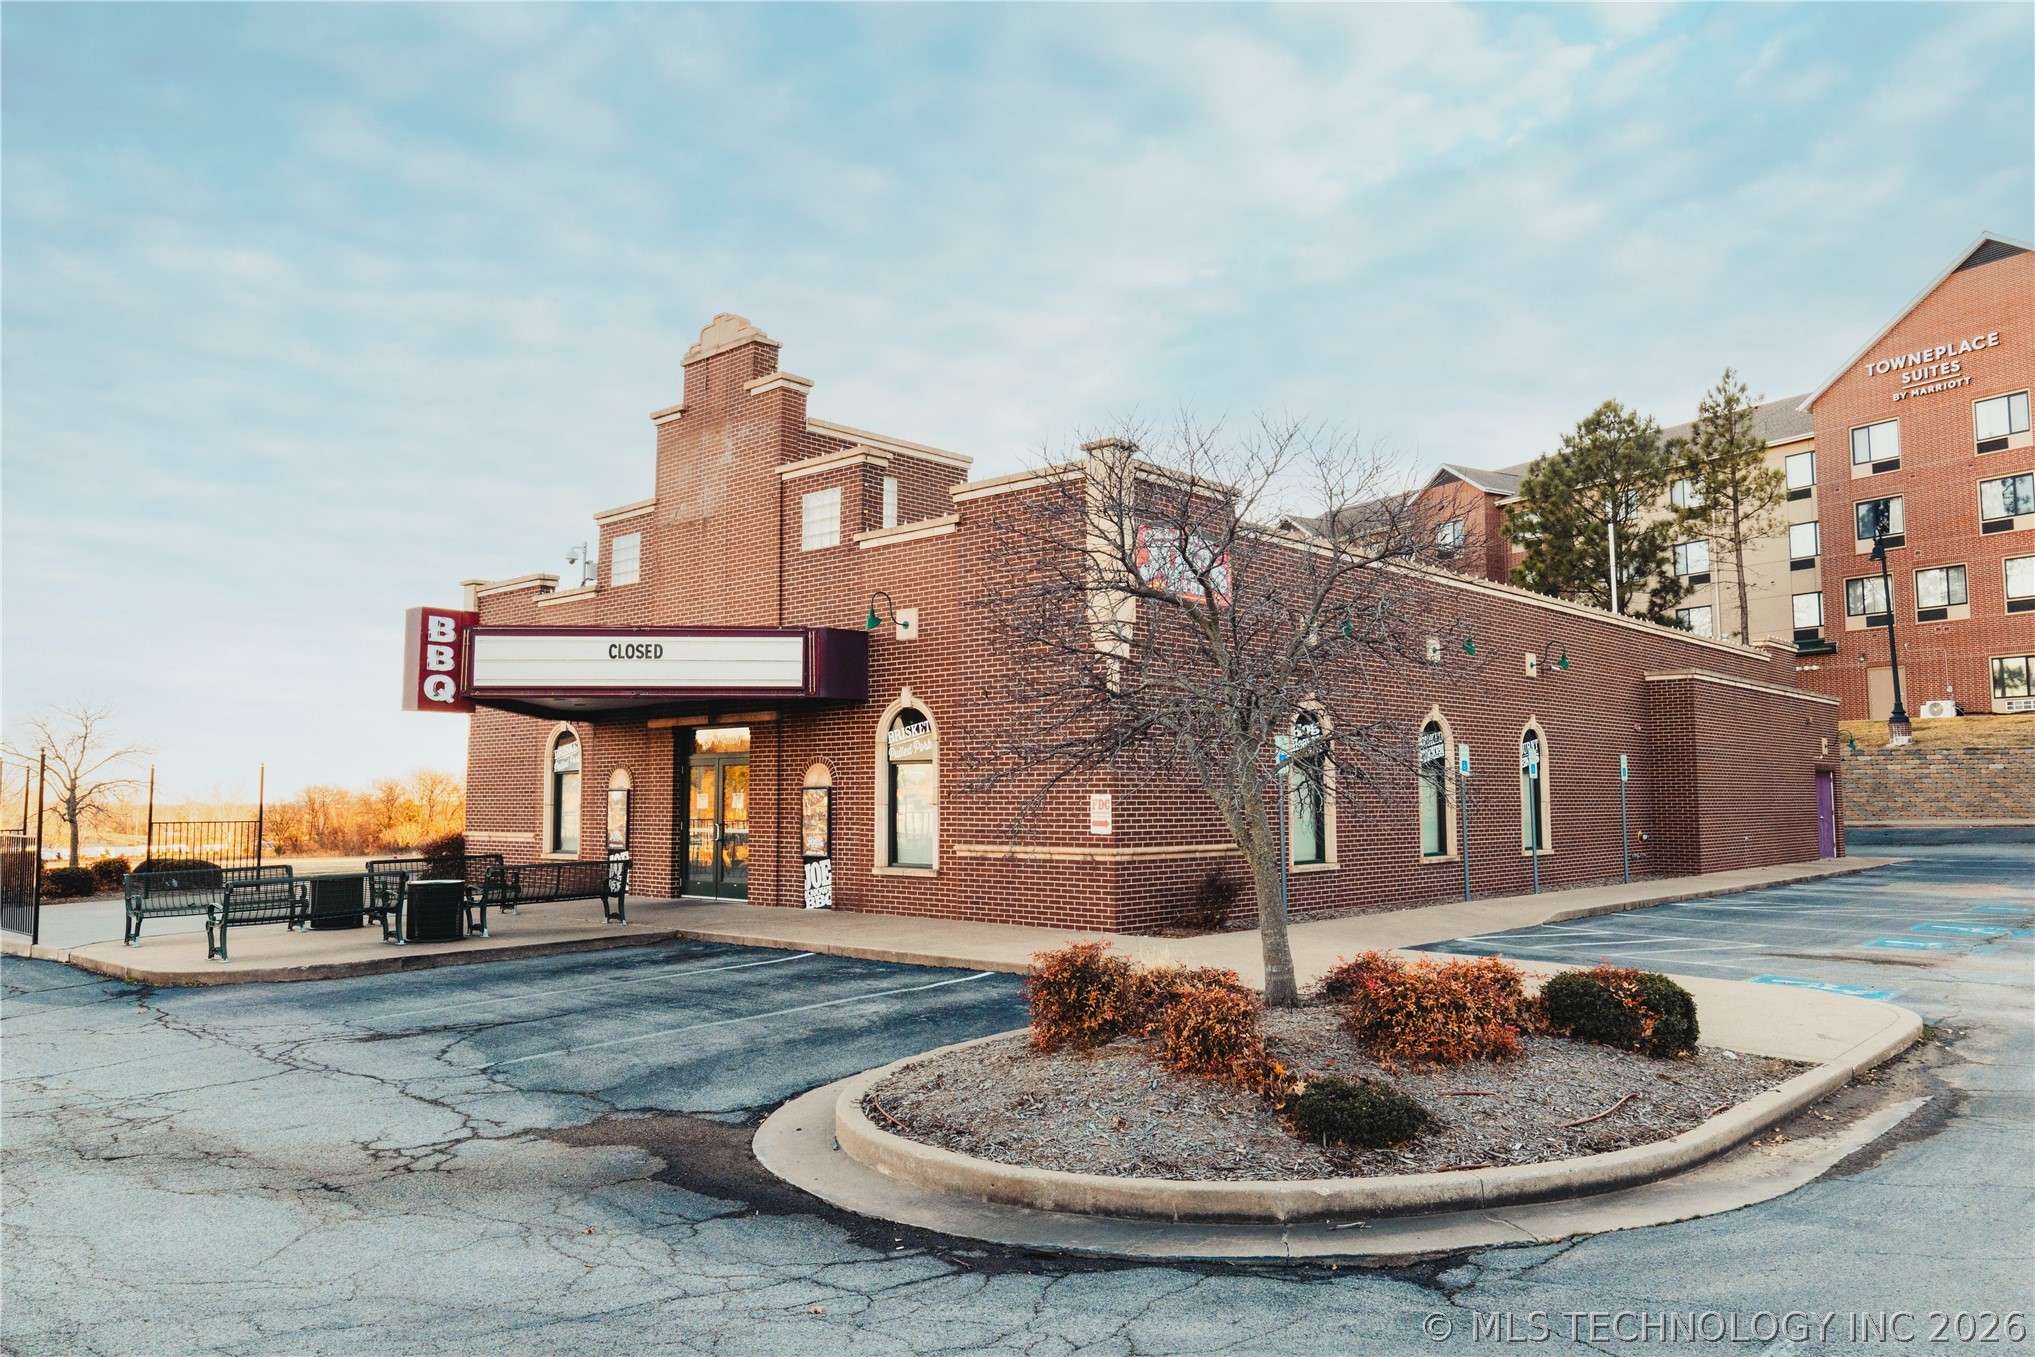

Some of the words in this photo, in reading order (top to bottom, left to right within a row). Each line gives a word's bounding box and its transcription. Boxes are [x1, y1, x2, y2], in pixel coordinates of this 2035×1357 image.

[1866, 332, 1999, 376] TOWNEPLACE
[1902, 360, 1961, 384] SUITES
[1892, 391, 1908, 402] BY
[1911, 377, 1971, 397] MARRIOTT
[423, 615, 457, 704] BBQ
[608, 643, 664, 660] CLOSED
[888, 720, 931, 744] BRISKET
[888, 744, 913, 761] Pulled
[913, 739, 933, 754] Pork
[1092, 799, 1110, 810] FDC
[804, 859, 832, 890] JOE
